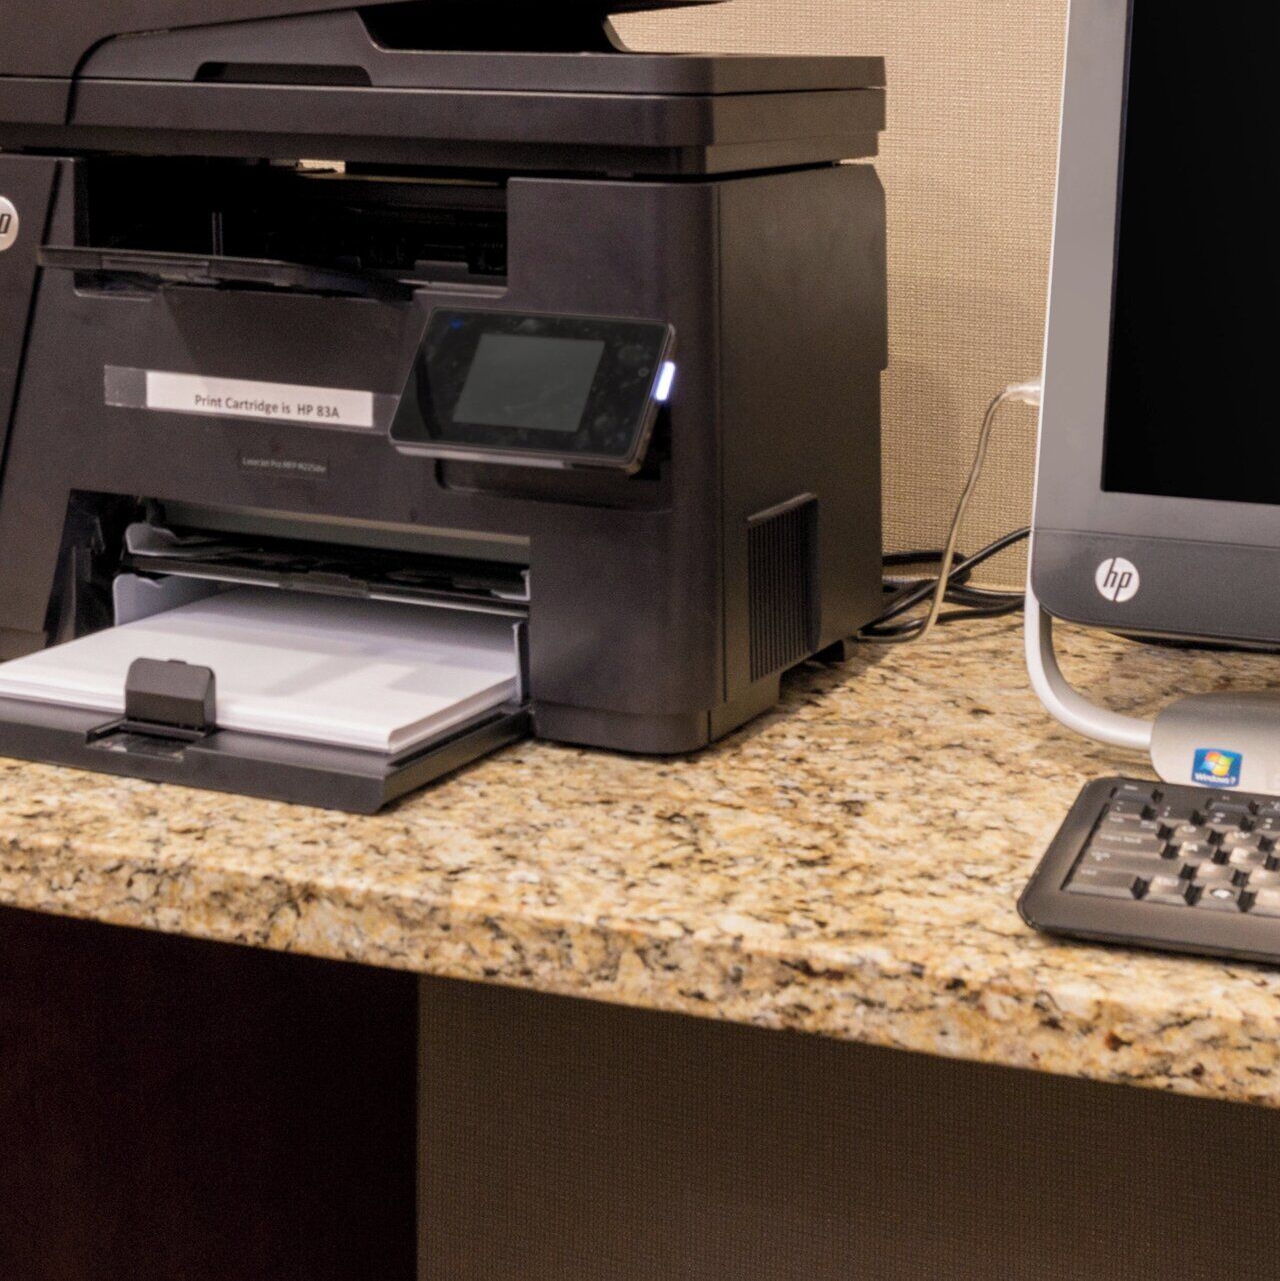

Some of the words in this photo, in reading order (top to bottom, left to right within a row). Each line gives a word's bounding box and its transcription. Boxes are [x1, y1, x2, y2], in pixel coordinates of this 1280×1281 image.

[195, 394, 221, 408] Print
[225, 397, 278, 414] Cartridge
[282, 402, 291, 414] is
[297, 403, 314, 415] HP
[316, 405, 340, 418] 83A
[1101, 558, 1134, 601] hp
[1194, 772, 1228, 785] Windows
